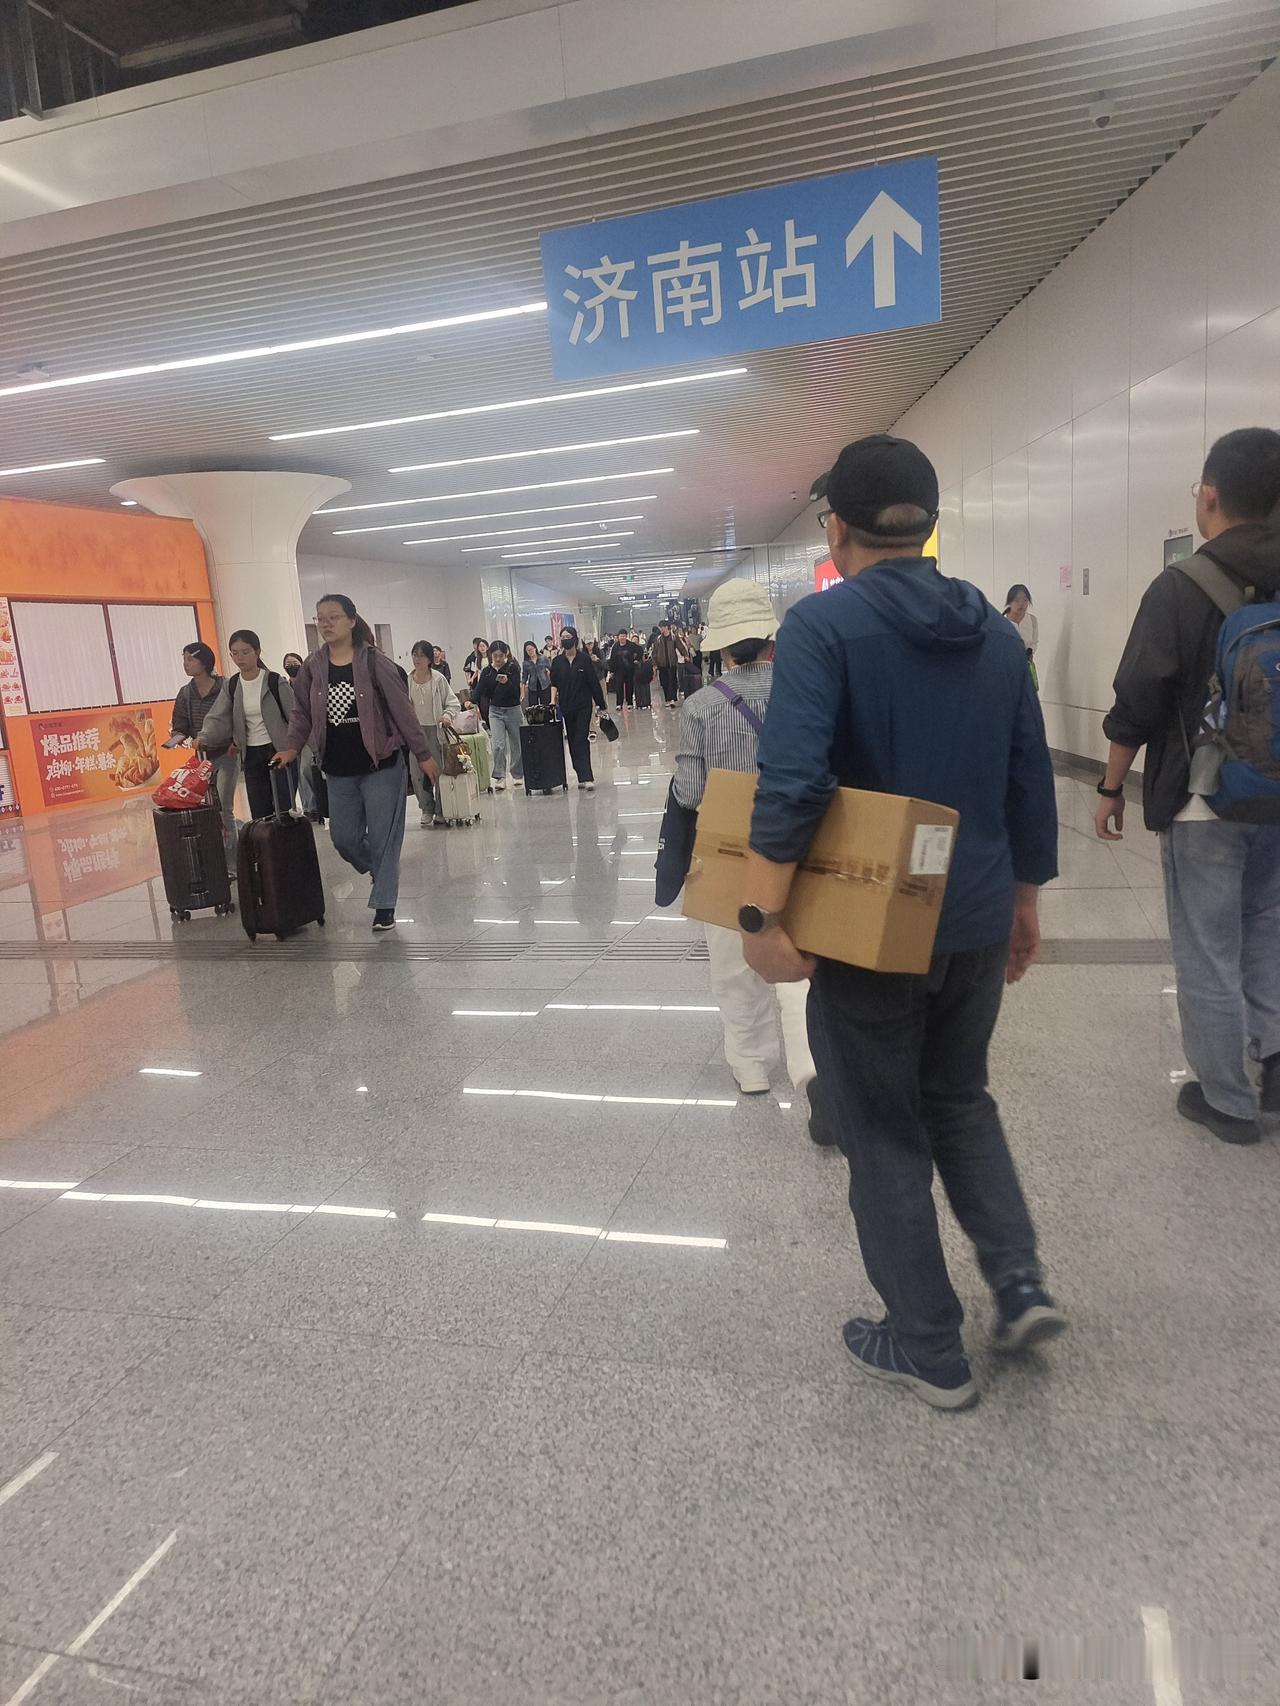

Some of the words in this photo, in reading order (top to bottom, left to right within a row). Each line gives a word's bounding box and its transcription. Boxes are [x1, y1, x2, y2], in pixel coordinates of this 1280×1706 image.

[563, 219, 817, 346] 济南站
[40, 728, 101, 756] 爆品推荐
